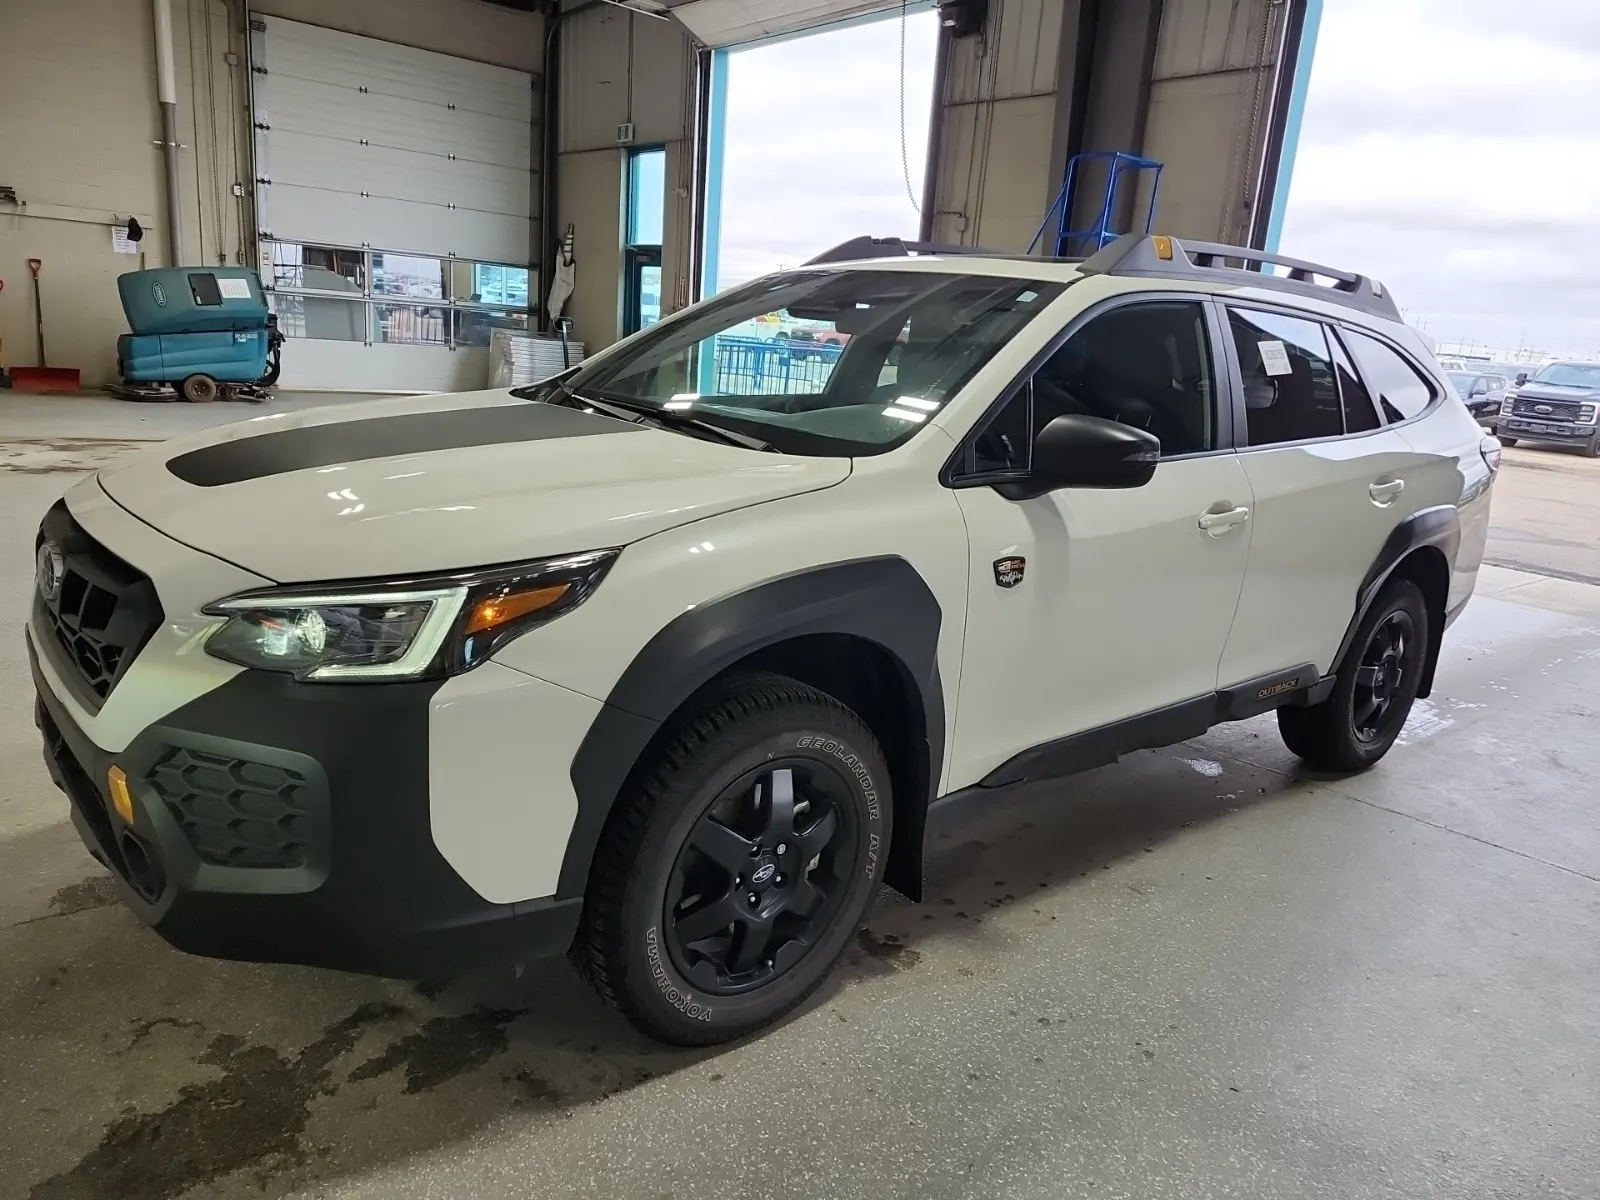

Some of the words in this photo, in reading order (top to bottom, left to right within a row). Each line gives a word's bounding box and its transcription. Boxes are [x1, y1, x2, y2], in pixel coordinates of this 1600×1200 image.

[1258, 680, 1297, 698] OUTBACK
[797, 736, 880, 820] GEOLANDAR
[865, 834, 880, 879] A/T
[646, 926, 712, 1022] YOKOHAMA
